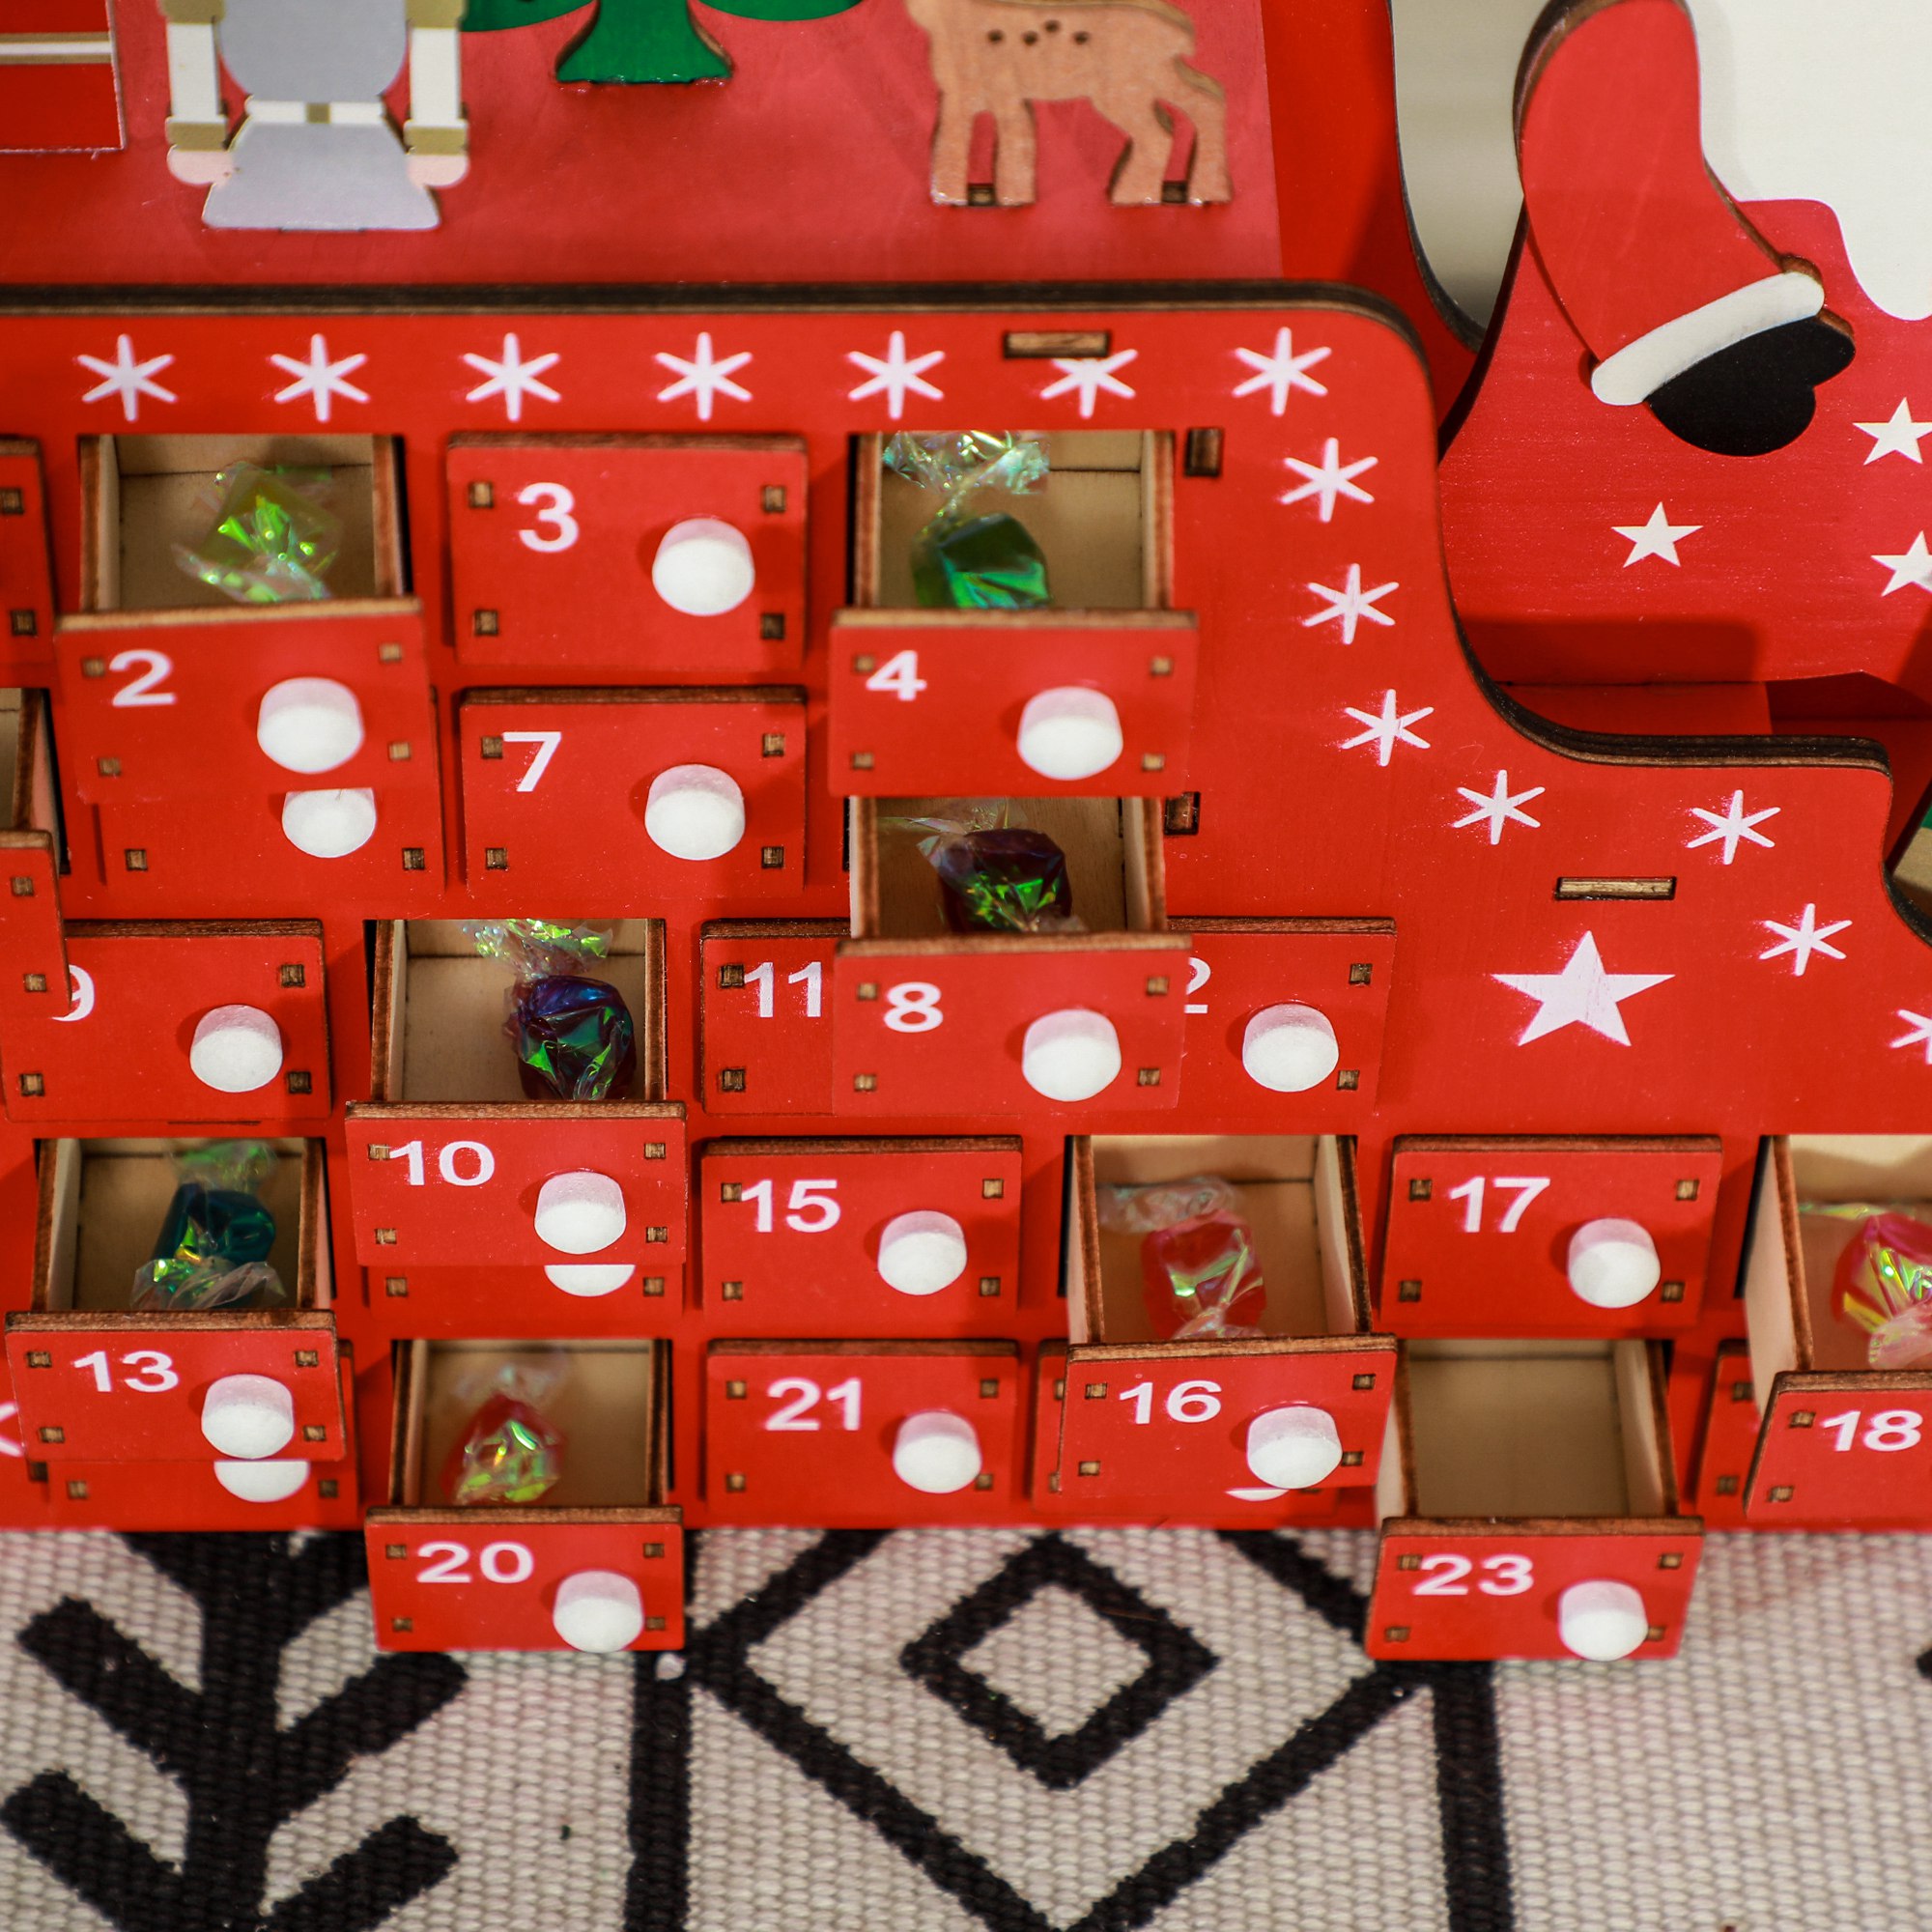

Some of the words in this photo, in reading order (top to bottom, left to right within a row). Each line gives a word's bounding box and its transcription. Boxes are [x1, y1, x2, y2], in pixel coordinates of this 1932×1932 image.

[517, 482, 579, 553] 3
[109, 649, 175, 707] 2
[866, 650, 927, 701] 4
[501, 731, 562, 792] 7
[743, 961, 822, 1018] 11
[883, 981, 944, 1033] 8
[388, 1140, 496, 1187] 10
[740, 1179, 841, 1234] 15
[1449, 1176, 1551, 1234] 17
[72, 1350, 180, 1393] 13
[764, 1378, 863, 1432] 21
[1118, 1379, 1223, 1425] 16
[1821, 1409, 1924, 1453] 18
[415, 1541, 534, 1584] 20
[1412, 1554, 1535, 1597] 23
